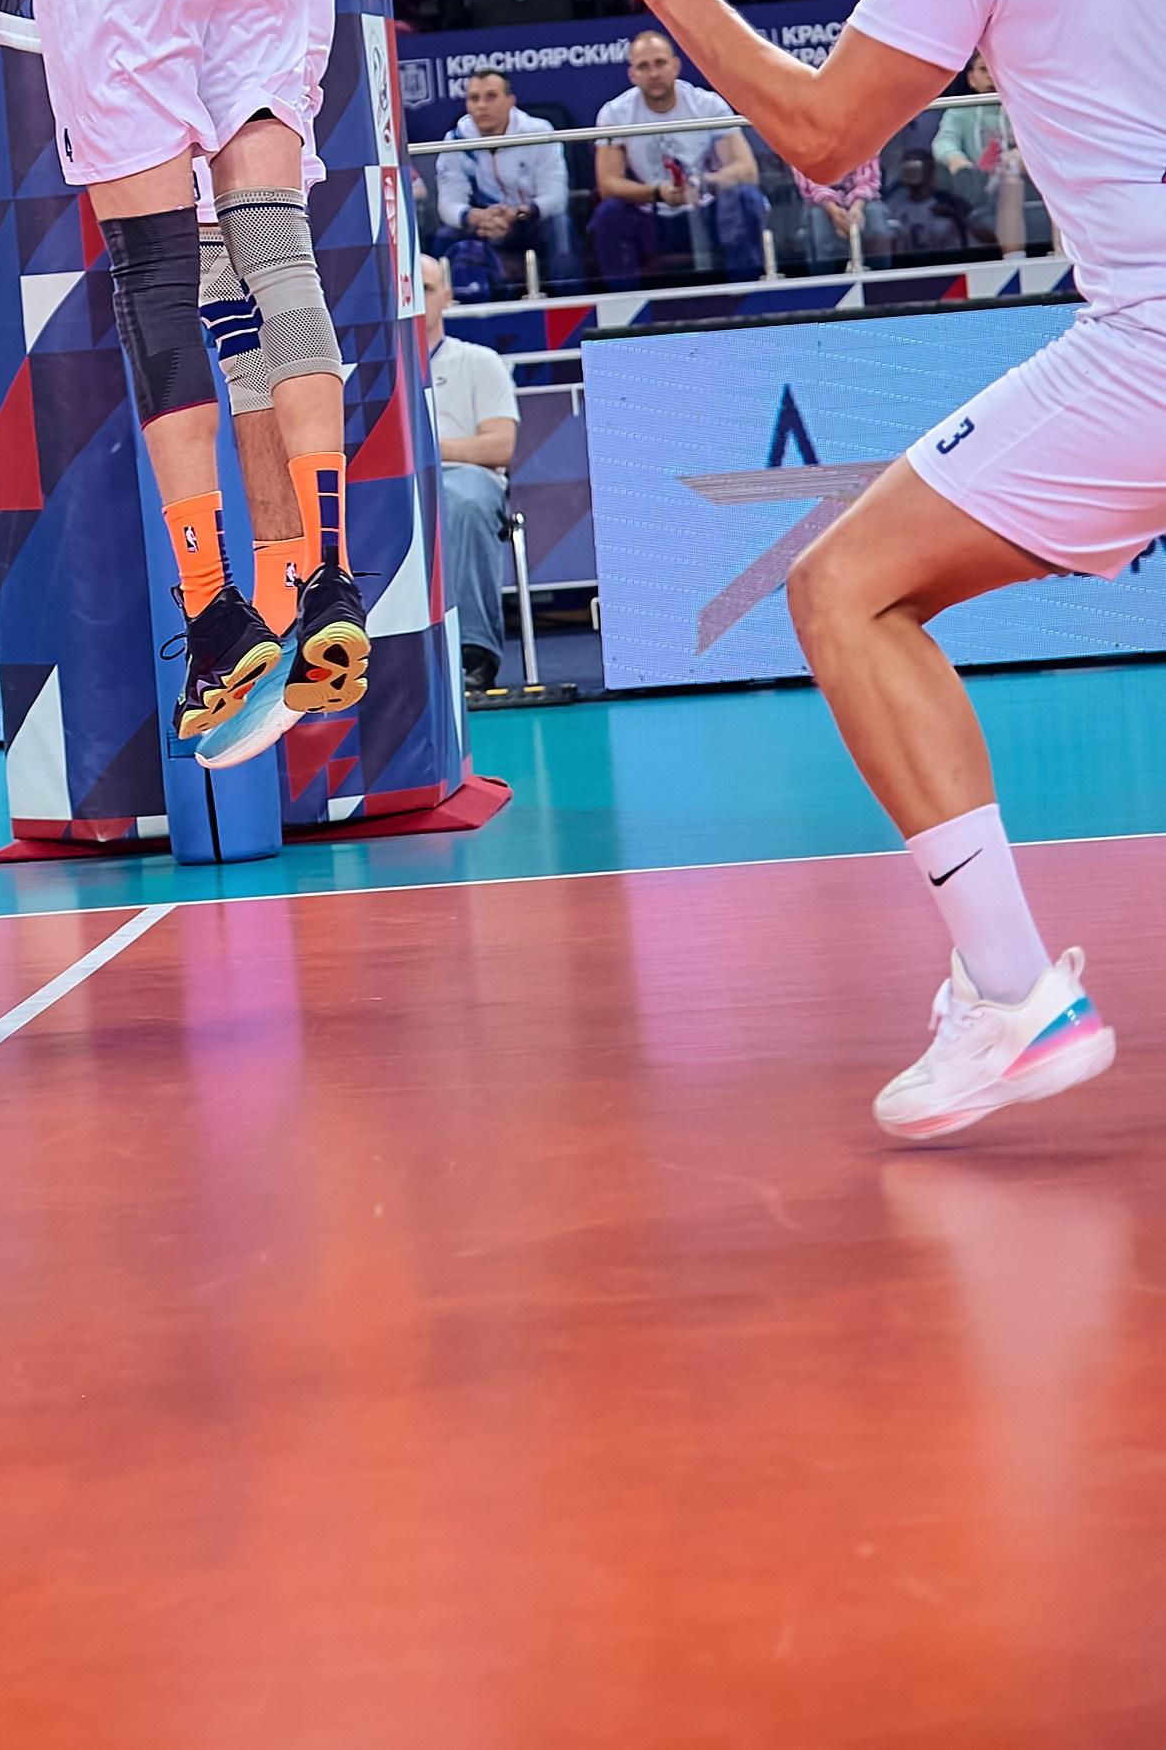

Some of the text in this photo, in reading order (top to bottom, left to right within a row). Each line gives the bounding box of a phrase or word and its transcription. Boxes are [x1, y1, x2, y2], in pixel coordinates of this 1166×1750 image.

[782, 21, 846, 47] КРАС
[446, 38, 631, 77] КРАСНОЯРСКИЙ
[64, 128, 74, 163] 4
[936, 416, 975, 454] 3
